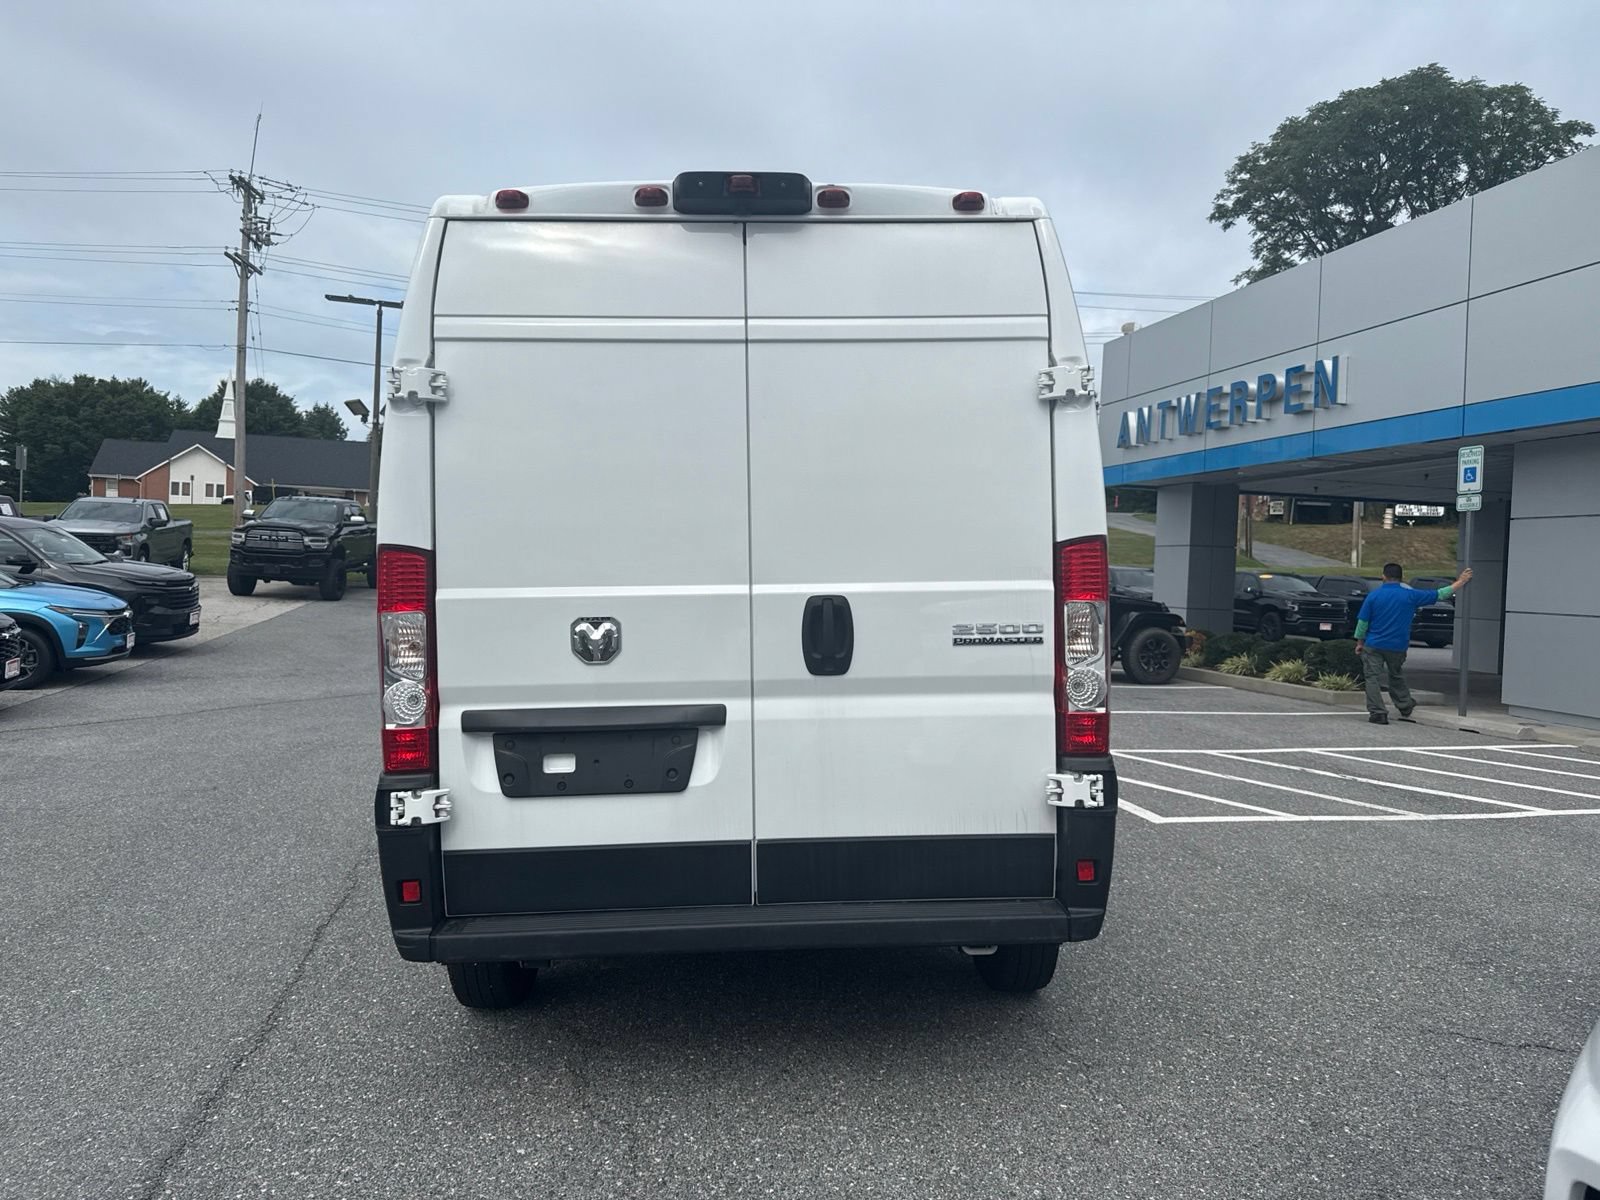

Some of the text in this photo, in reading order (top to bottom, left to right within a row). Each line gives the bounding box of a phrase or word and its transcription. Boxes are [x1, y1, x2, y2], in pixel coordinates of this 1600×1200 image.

[1117, 355, 1346, 448] ANTWERPEN
[1460, 450, 1481, 458] RESERVED
[952, 624, 1044, 636] 2500
